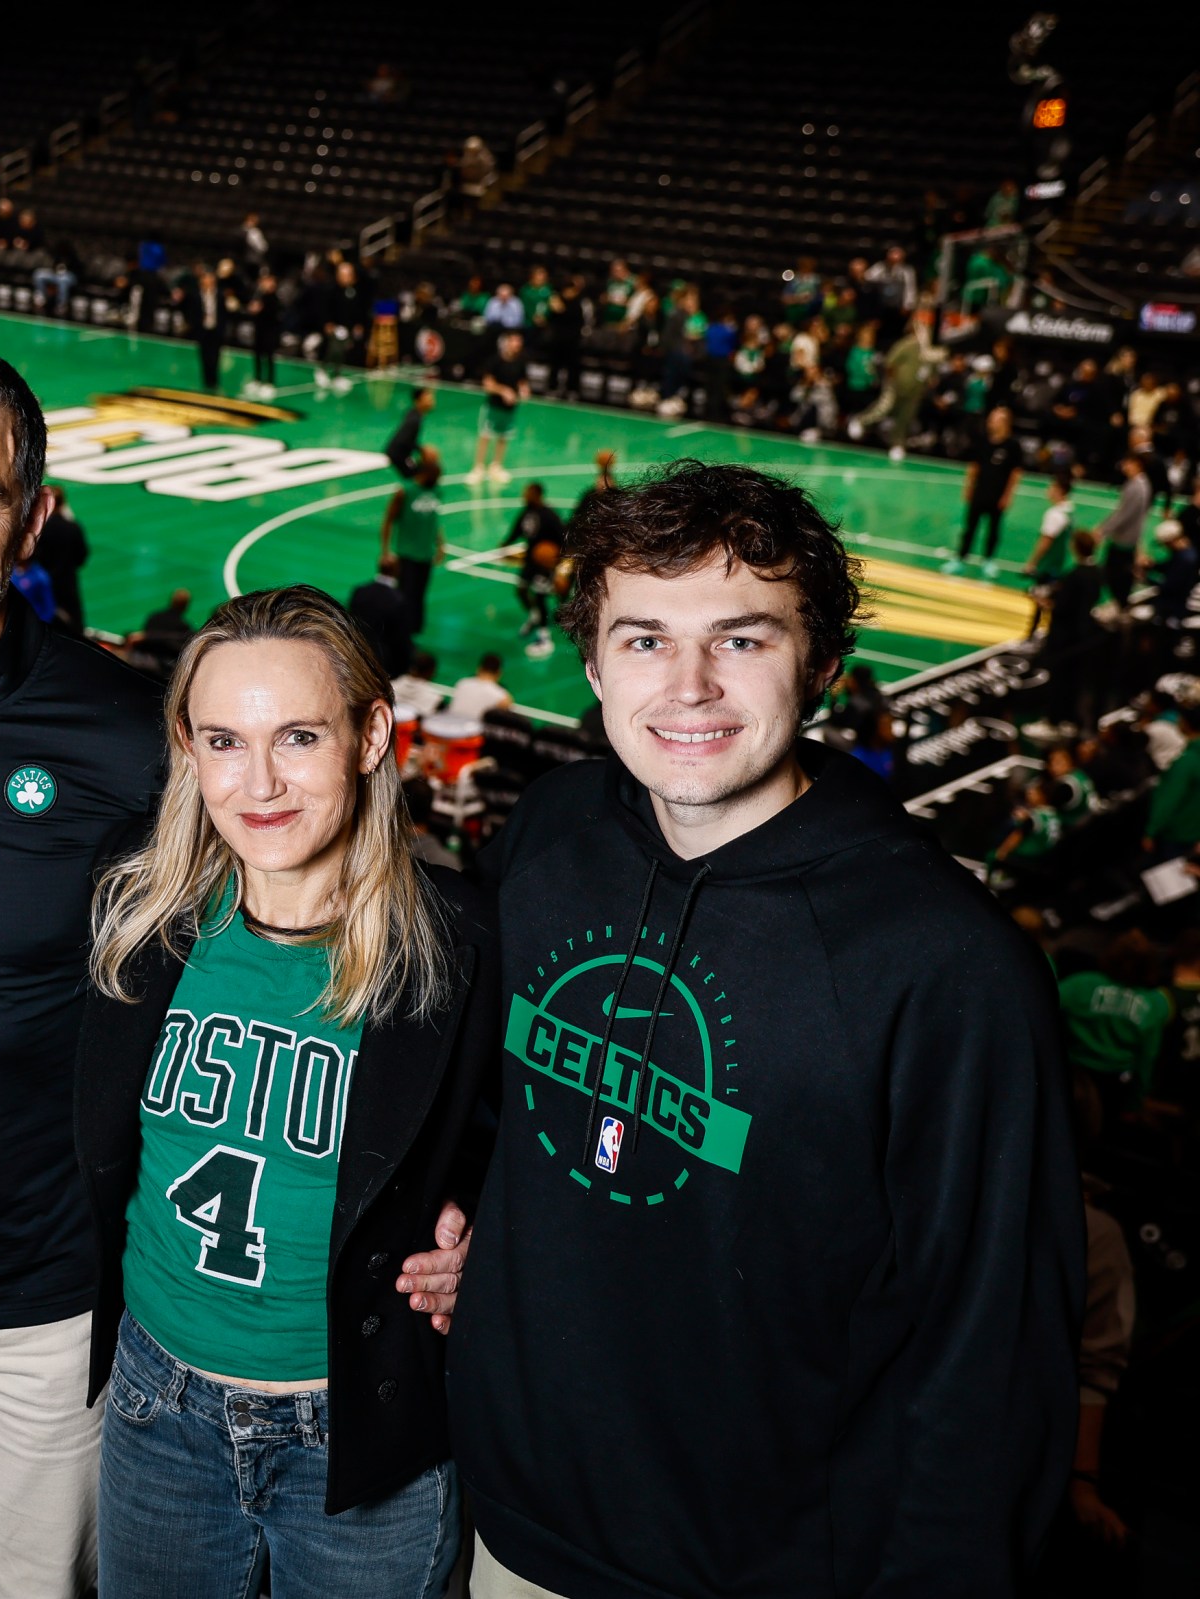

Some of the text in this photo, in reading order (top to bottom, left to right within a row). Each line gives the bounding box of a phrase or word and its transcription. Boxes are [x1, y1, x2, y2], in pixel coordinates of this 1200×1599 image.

[11, 770, 52, 790] CELTICS
[525, 1013, 711, 1150] CELTICS
[640, 925, 739, 1095] BAKETBALL
[140, 1008, 359, 1164] OSTO
[166, 1144, 267, 1288] 4
